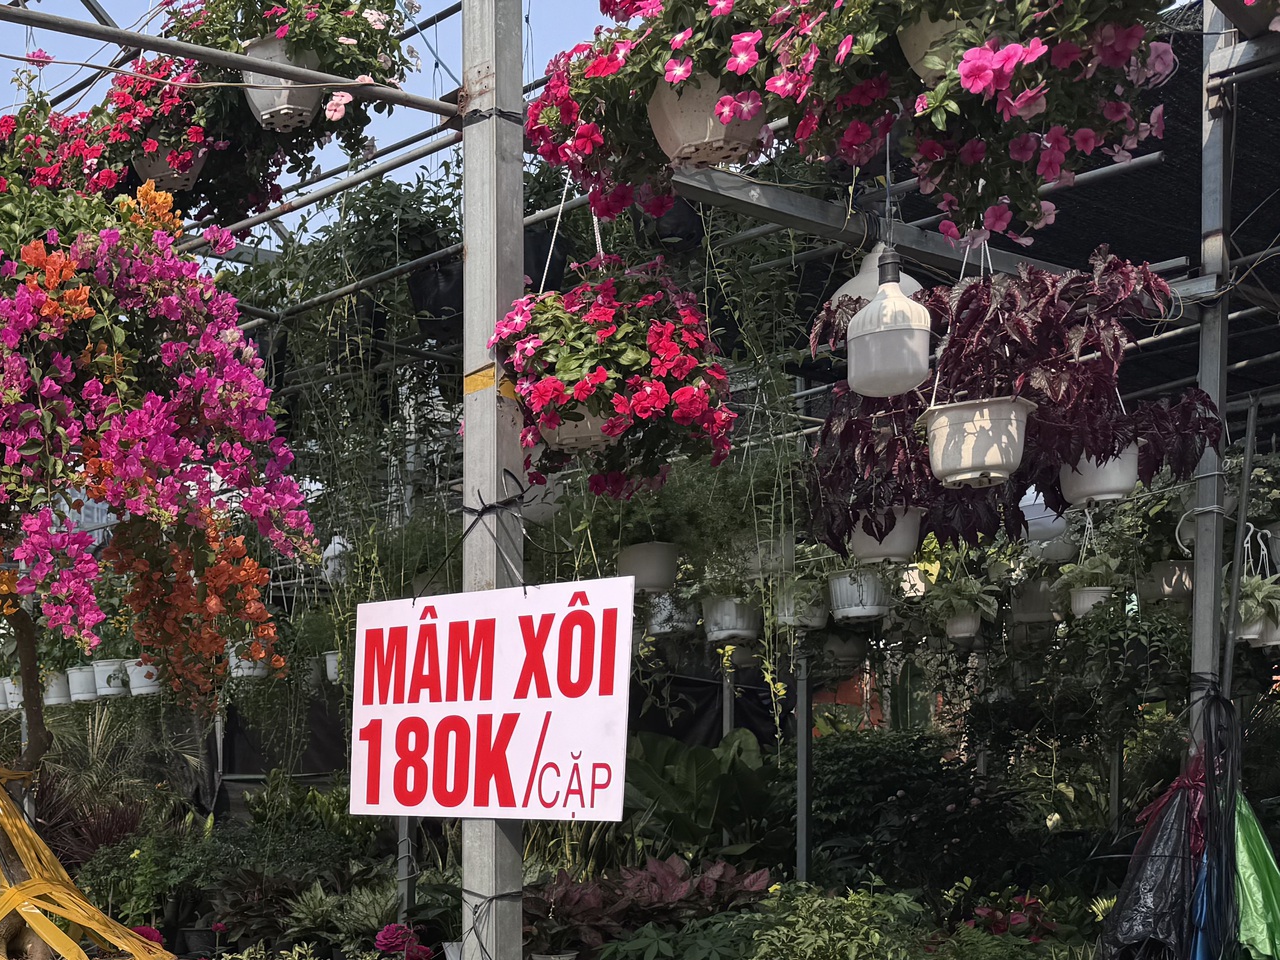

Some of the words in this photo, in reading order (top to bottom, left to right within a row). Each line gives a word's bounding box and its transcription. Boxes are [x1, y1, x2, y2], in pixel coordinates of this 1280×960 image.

[362, 605, 496, 706] MÂM
[513, 591, 618, 700] XÔI
[359, 711, 612, 818] 180K/CẶP
